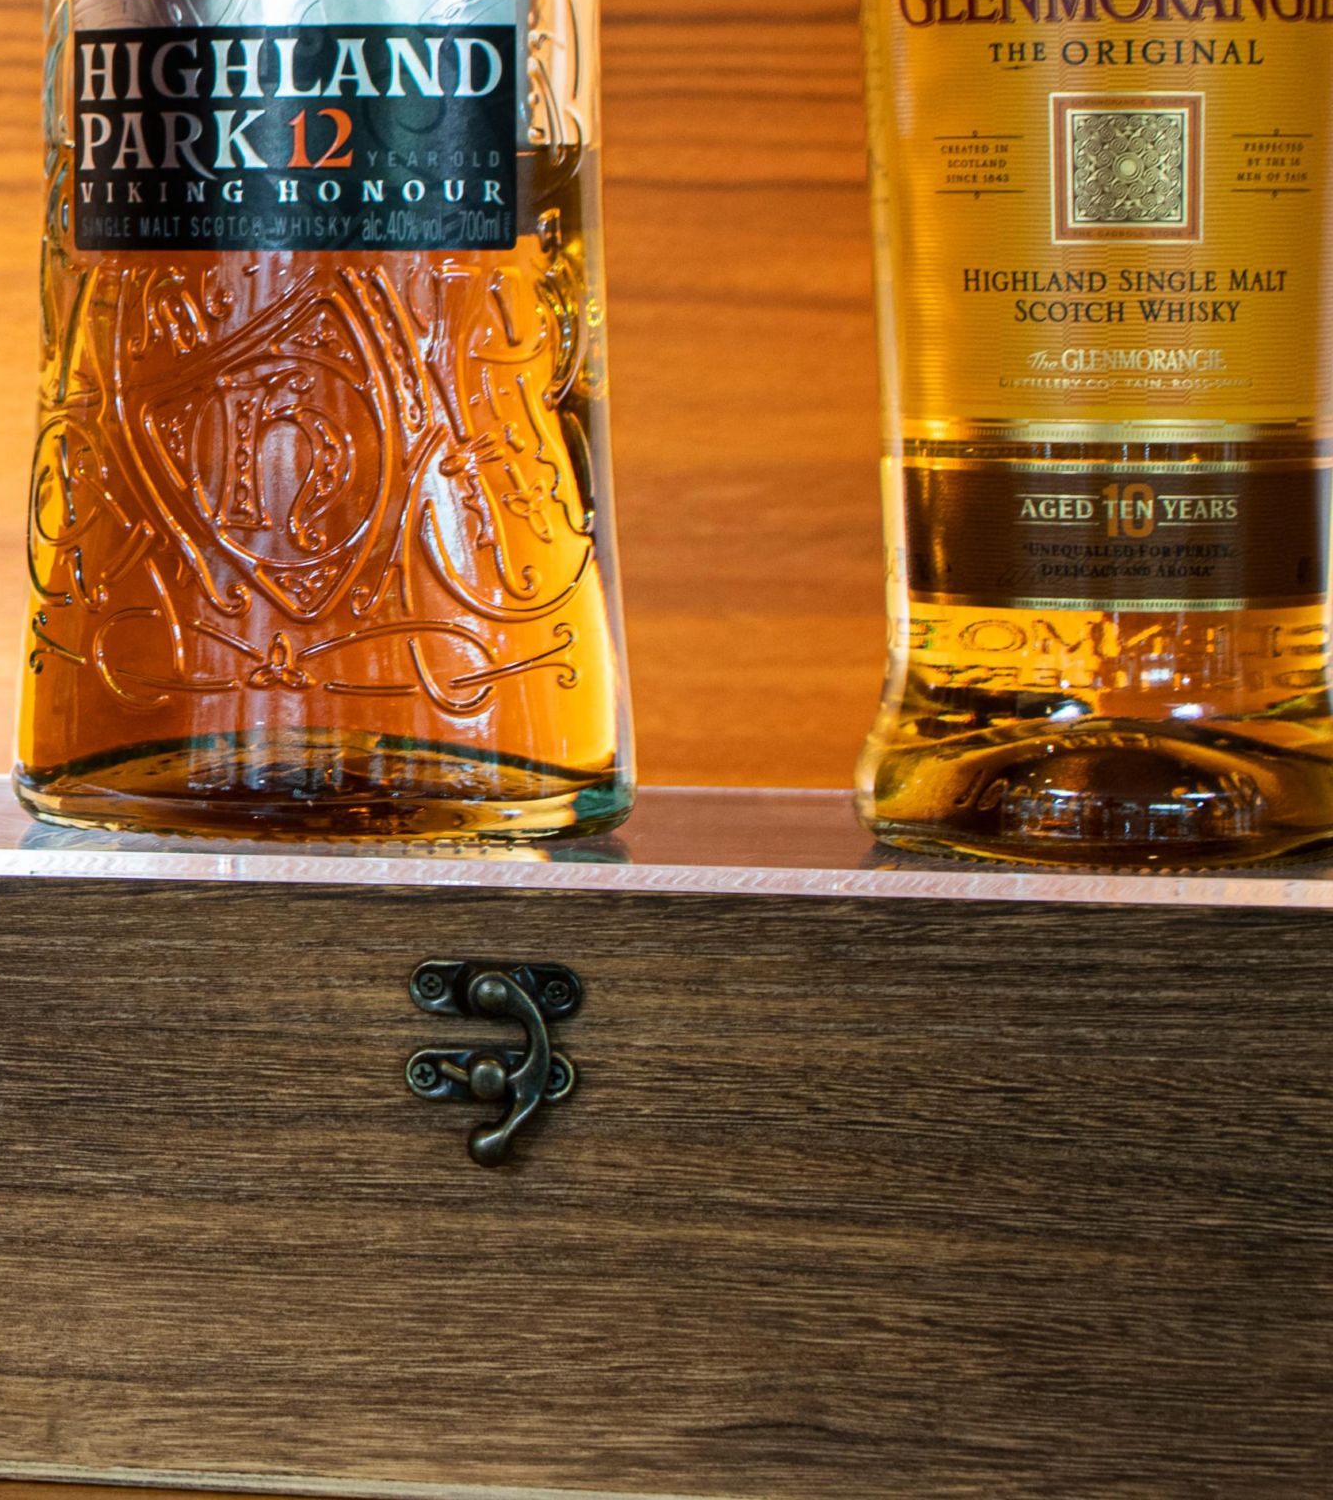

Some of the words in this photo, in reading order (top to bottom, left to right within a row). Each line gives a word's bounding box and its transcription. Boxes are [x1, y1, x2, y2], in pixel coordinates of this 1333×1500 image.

[989, 42, 1047, 63] THE
[1061, 39, 1264, 66] ORIGINAL
[80, 37, 504, 100] HIGHLAND
[79, 109, 269, 181] PARK
[286, 107, 355, 169] 12
[366, 150, 439, 168] YEAR
[453, 150, 501, 168] OLD
[940, 144, 989, 154] CREATED
[995, 144, 1009, 153] IN
[948, 160, 1007, 168] SCOTLAND
[1247, 158, 1261, 167] BY
[1267, 158, 1286, 166] THE
[946, 174, 978, 183] SINCE
[1236, 172, 1261, 181] MEN
[80, 180, 244, 203] VIKING
[277, 179, 505, 204] HONOUR
[82, 216, 131, 237] SINGLE
[140, 216, 181, 237] MALT
[190, 216, 263, 237] SCOTCH
[274, 215, 352, 237] WHISKY
[458, 211, 501, 241] 700ml
[962, 269, 1107, 292] HIGHLAND
[1118, 269, 1218, 292] SINGLE
[1228, 269, 1288, 292] MALT
[1014, 300, 1126, 323] SCOTCH
[1139, 300, 1241, 323] WHISKY
[1027, 350, 1059, 371] The
[1060, 348, 1227, 372] GLENMORANGIE
[1020, 498, 1094, 520] AGED
[1102, 499, 1154, 520] TEN
[1163, 499, 1239, 520] YEARS
